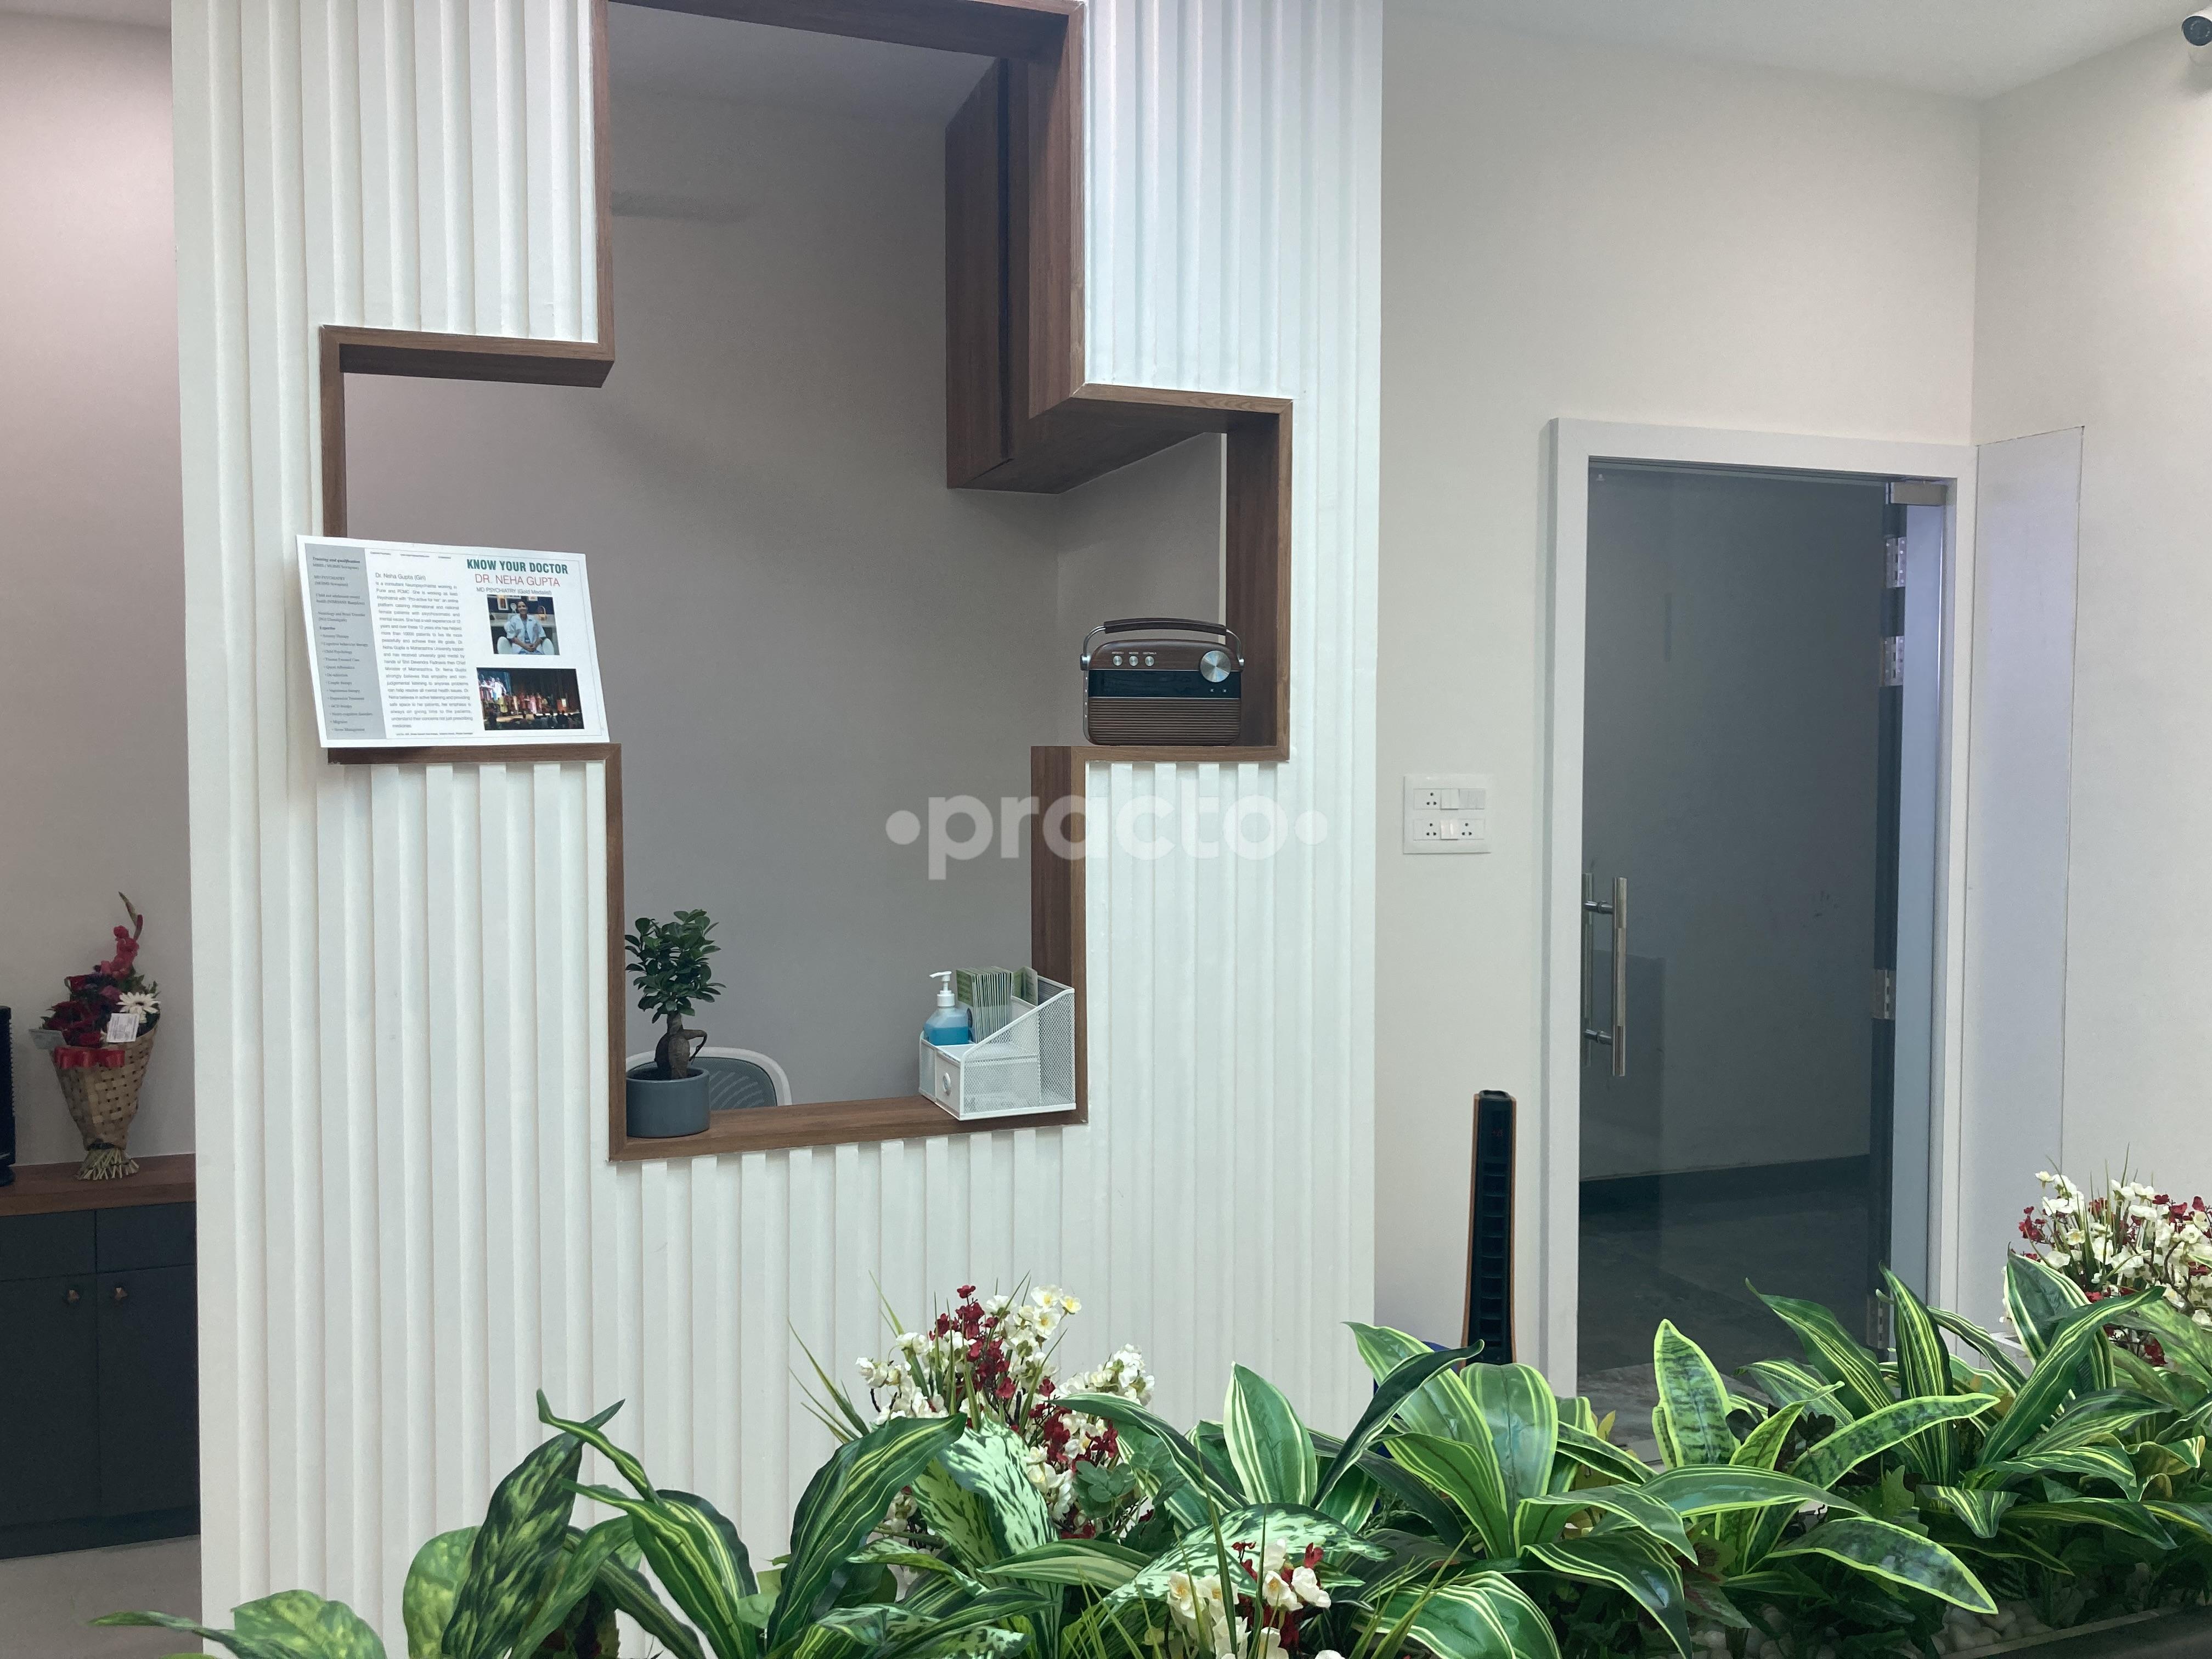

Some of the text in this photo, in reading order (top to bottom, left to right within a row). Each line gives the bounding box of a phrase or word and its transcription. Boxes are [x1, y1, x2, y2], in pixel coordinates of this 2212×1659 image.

[466, 558, 568, 574] KNOW YOUR DOCTOR
[475, 574, 560, 587] DR. NEHA GUPTA
